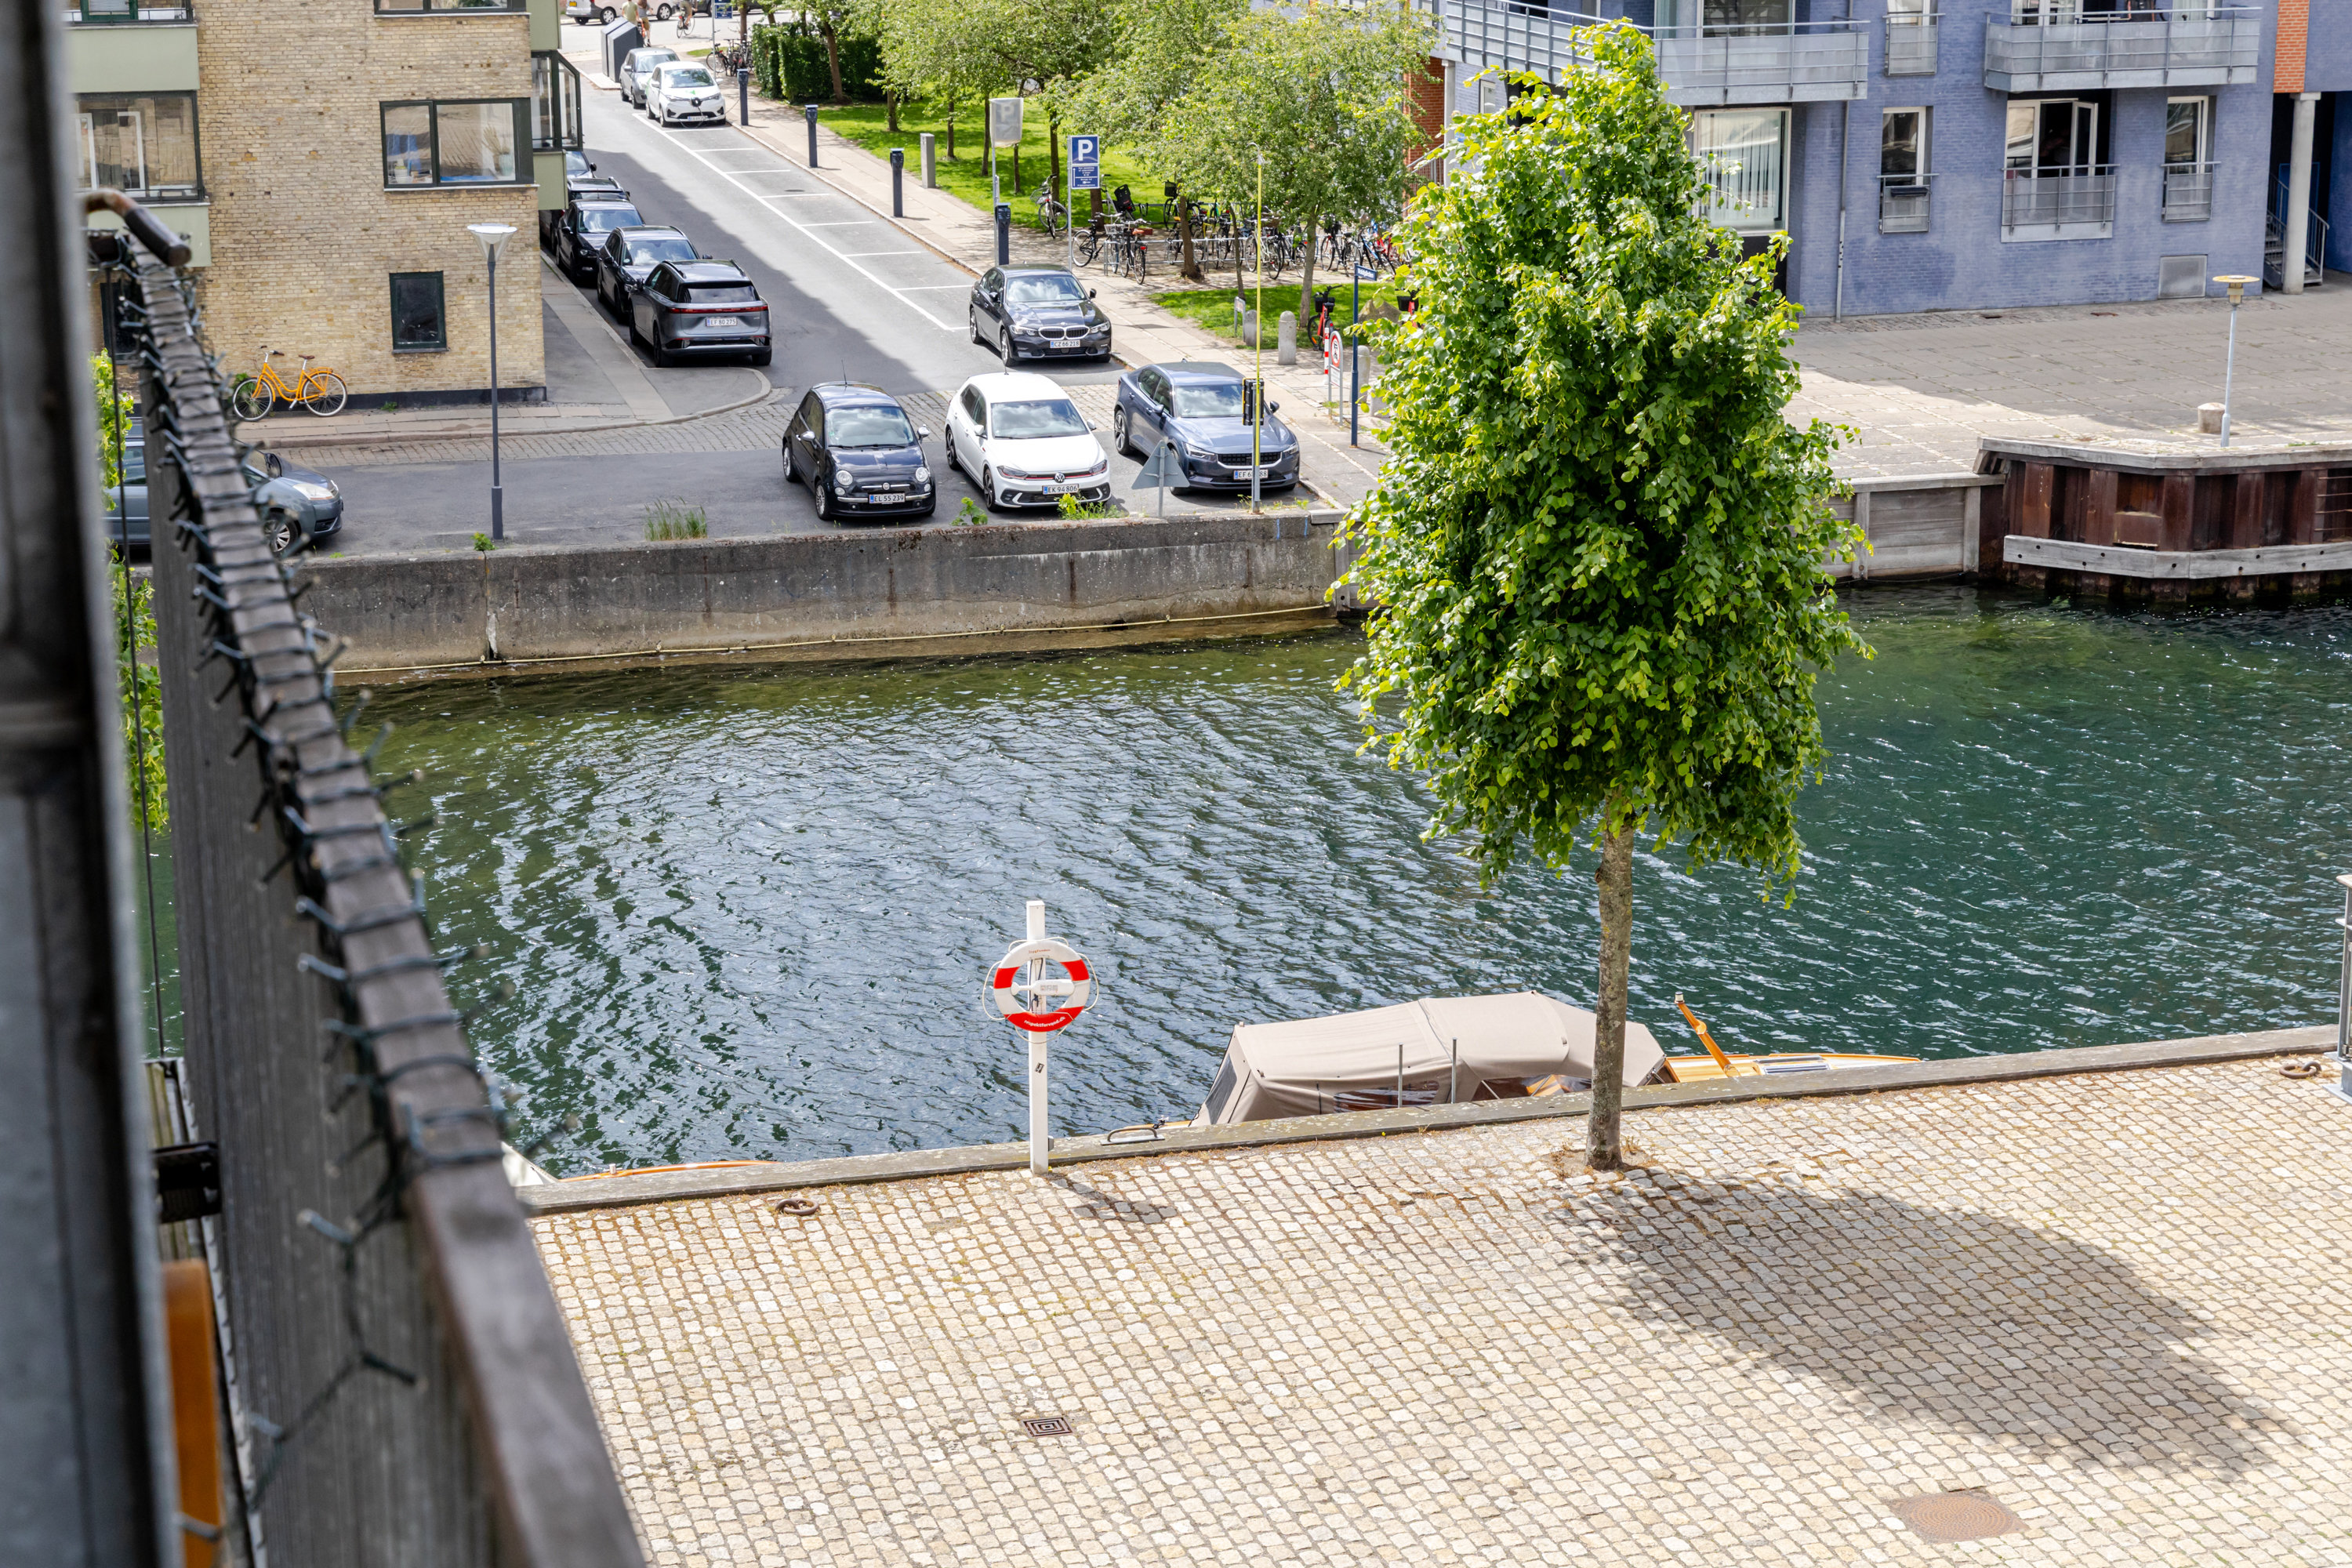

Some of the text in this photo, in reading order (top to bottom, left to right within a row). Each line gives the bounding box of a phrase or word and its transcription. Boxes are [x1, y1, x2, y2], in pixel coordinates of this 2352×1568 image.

[1000, 103, 1014, 122] P
[1078, 140, 1093, 161] P
[1024, 1016, 1066, 1027] respektforvand.dk
